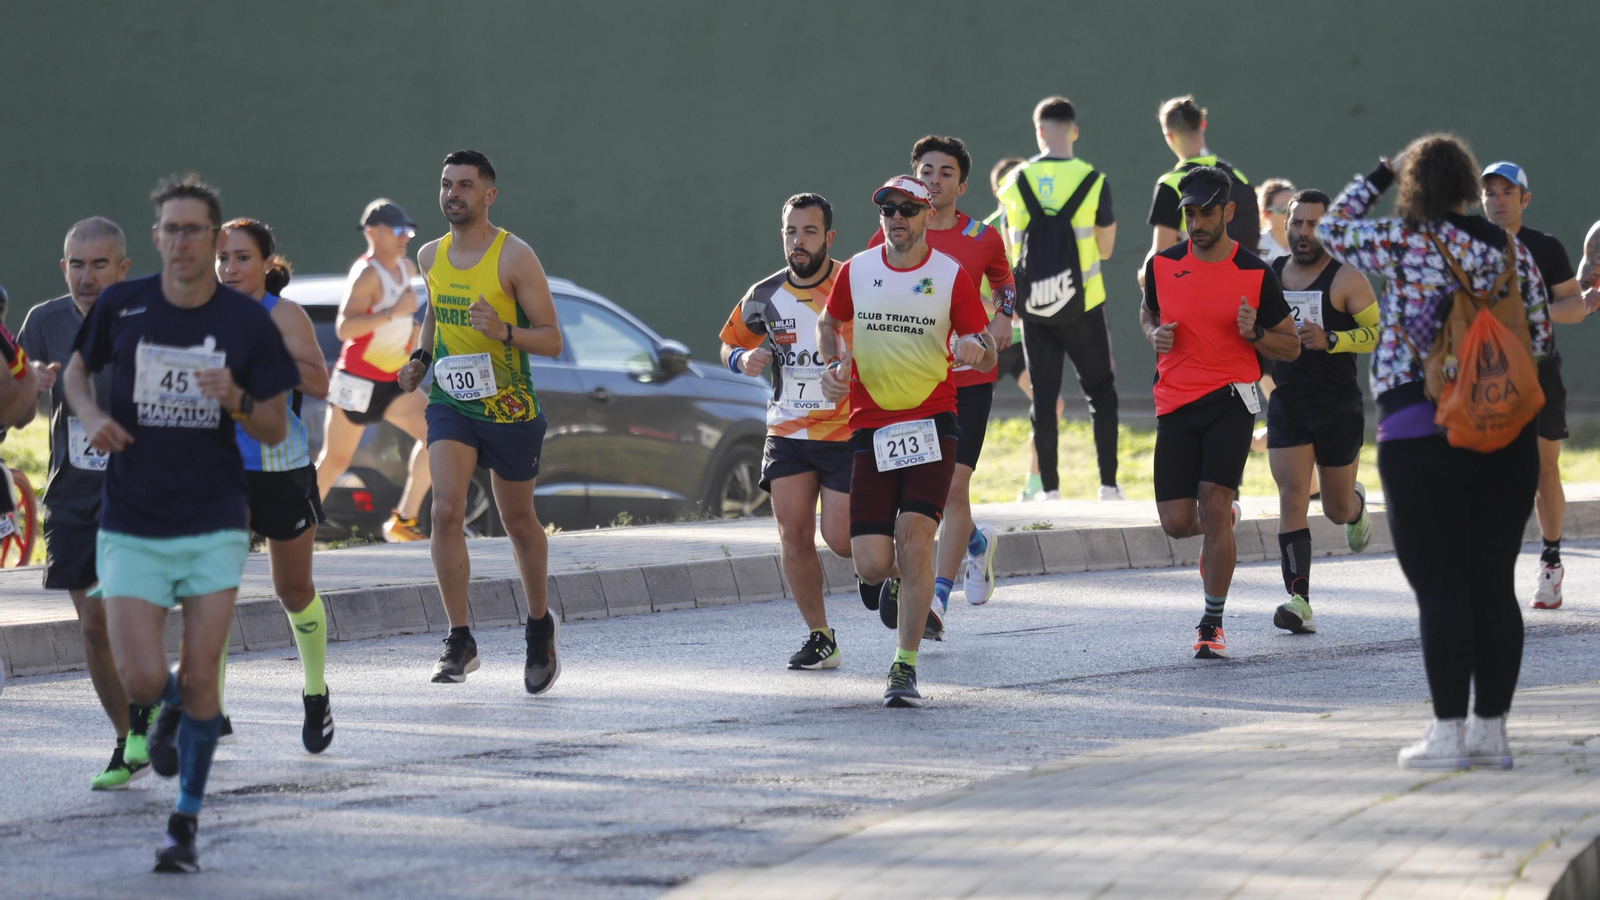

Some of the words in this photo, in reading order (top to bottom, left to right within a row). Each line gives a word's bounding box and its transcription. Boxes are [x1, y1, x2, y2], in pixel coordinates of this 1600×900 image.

[1030, 268, 1074, 307] NIKE
[437, 294, 471, 307] RUNNERS
[775, 319, 794, 328] MILAR
[857, 311, 882, 321] CLUB
[885, 313, 936, 326] TRIATLÓN
[866, 323, 924, 336] ALGECIRAS
[160, 370, 189, 394] 45
[446, 371, 475, 390] 130
[797, 383, 806, 399] 7
[887, 436, 919, 458] 213
[894, 456, 926, 467] EVOS
